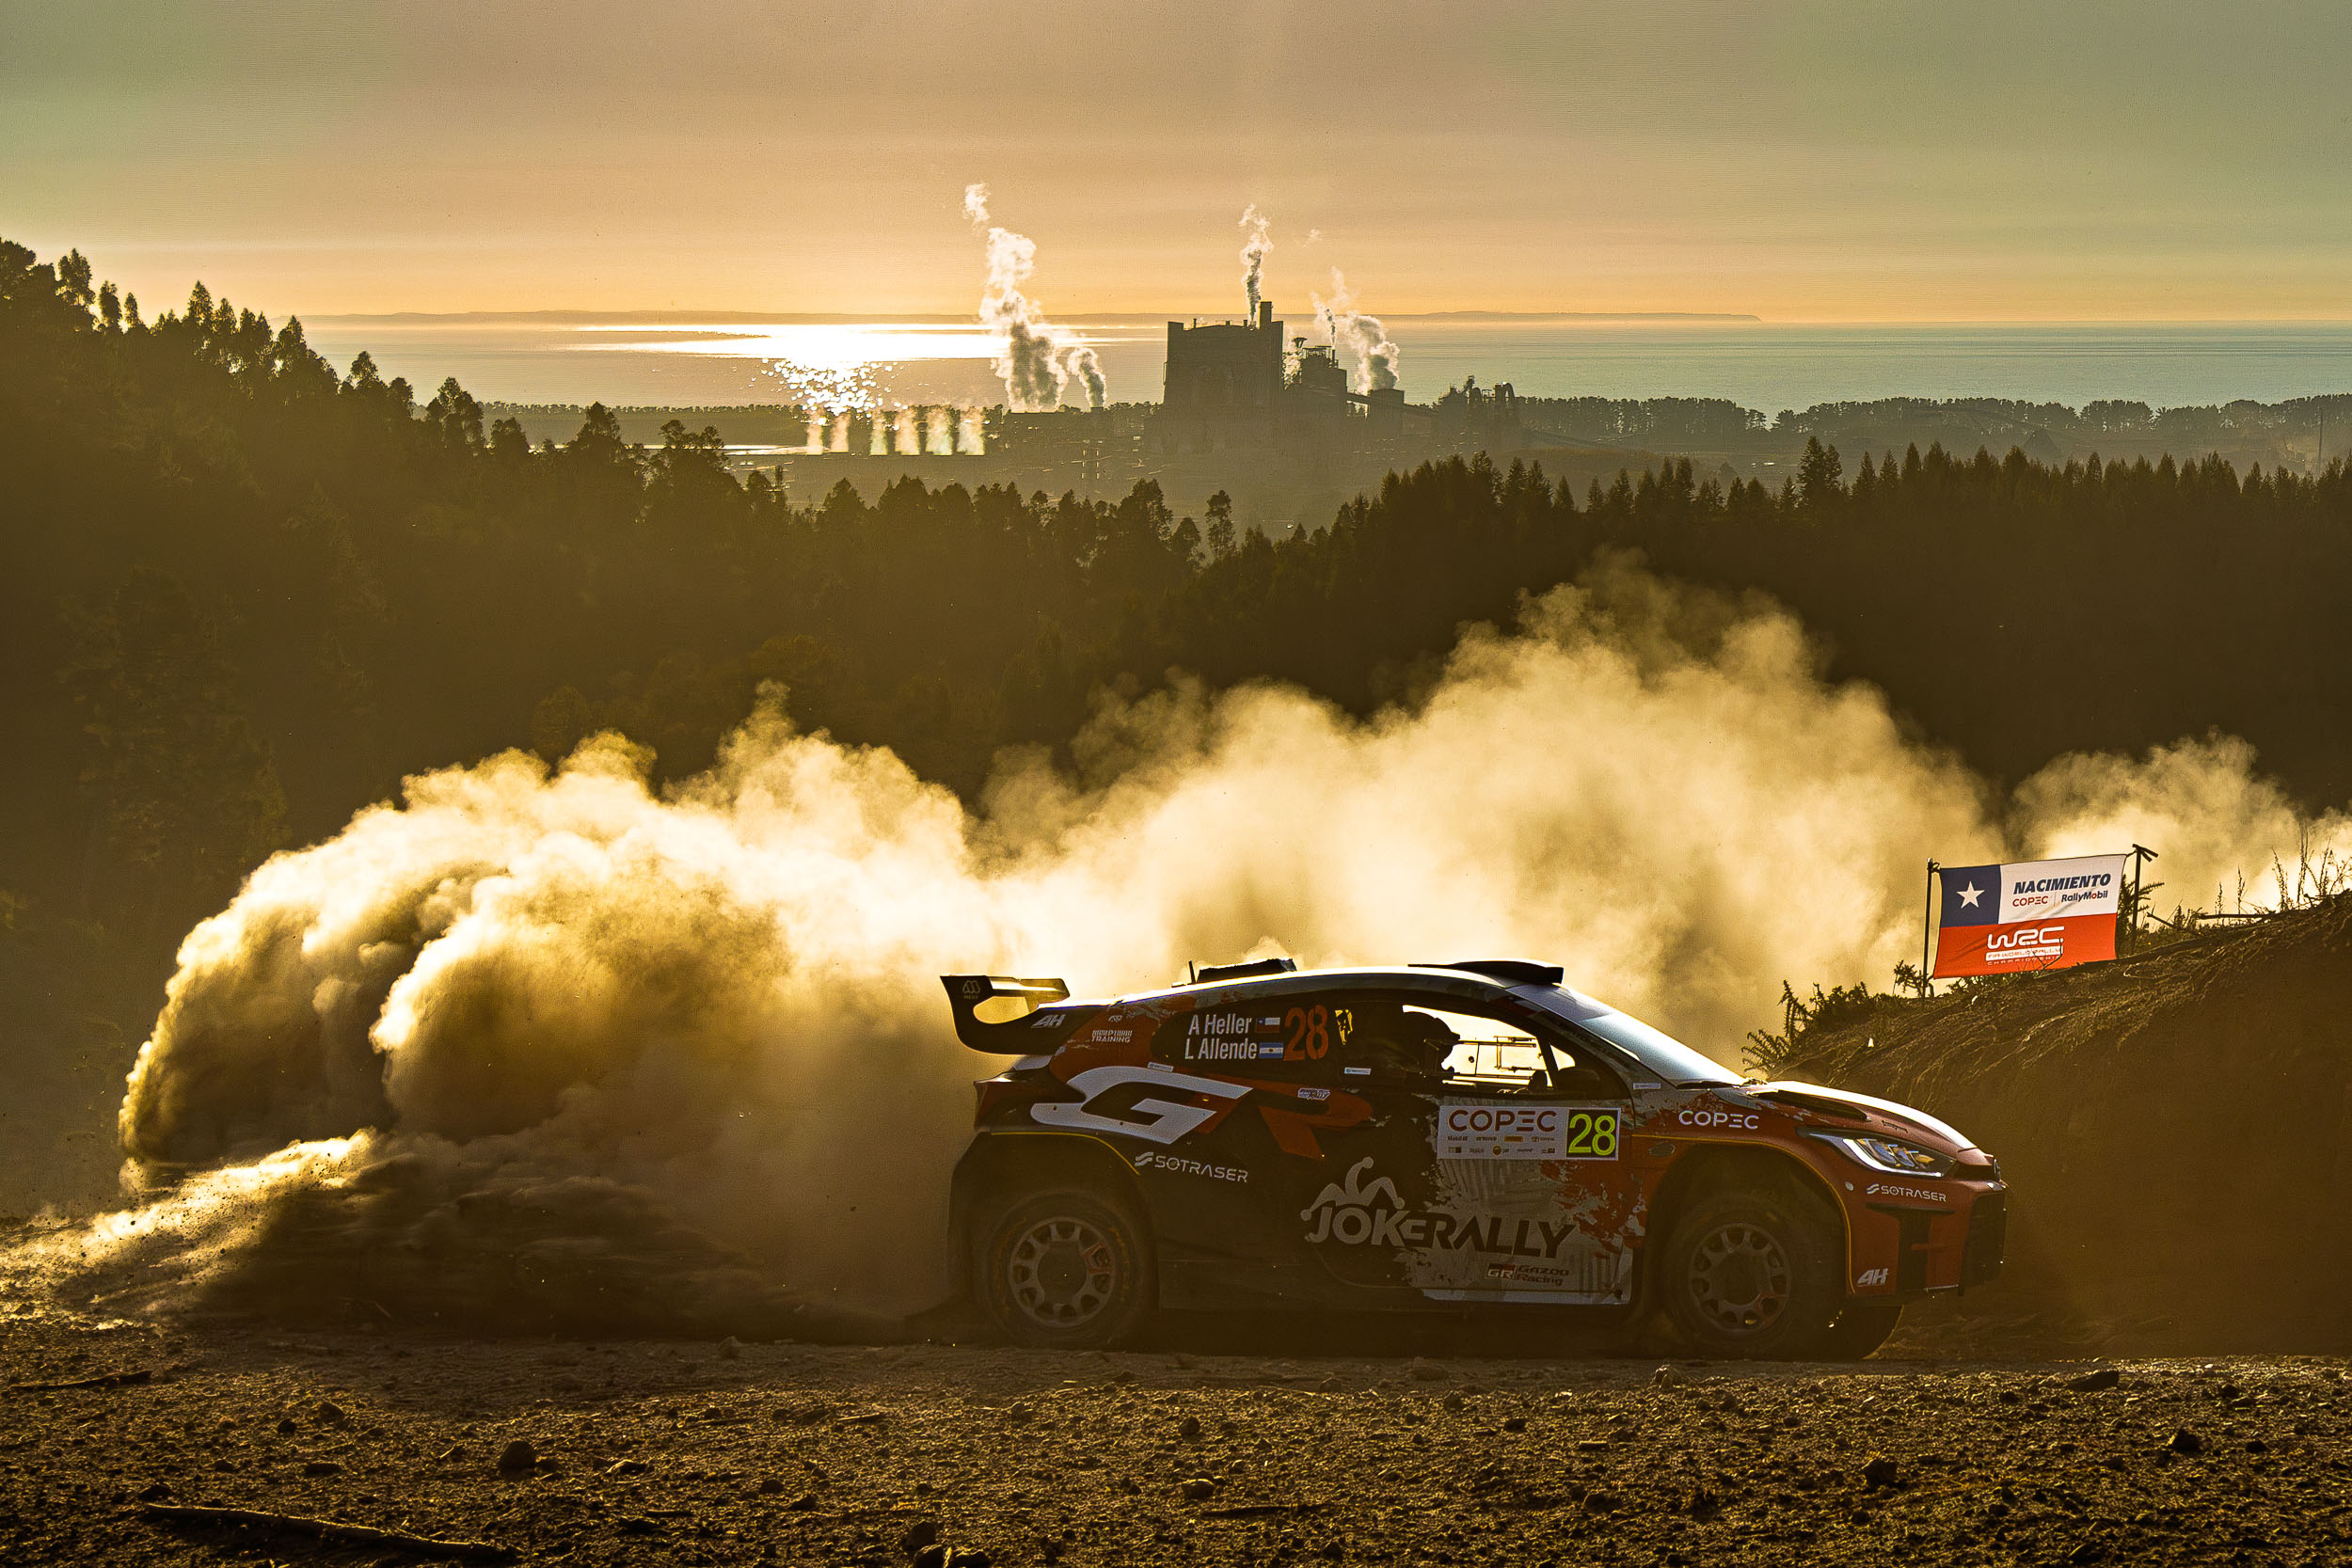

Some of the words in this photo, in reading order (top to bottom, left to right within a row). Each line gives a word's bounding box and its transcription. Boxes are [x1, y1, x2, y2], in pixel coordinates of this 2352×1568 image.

[2013, 873, 2111, 895] NACIMIENTO
[2012, 895, 2049, 907] COPEC
[2061, 890, 2108, 903] RallyMobil
[1987, 926, 2065, 950] WRC
[1188, 1015, 1200, 1036] A
[1204, 1013, 1252, 1035] Heller
[1283, 1005, 1329, 1062] 28
[1184, 1037, 1194, 1060] L
[1198, 1037, 1257, 1060] Allende
[1448, 1109, 1557, 1132] COPEC
[1678, 1110, 1759, 1130] COPEC
[1566, 1113, 1616, 1157] 28
[1154, 1154, 1248, 1183] SOTRASER
[1881, 1185, 1947, 1202] SOTRASER
[1305, 1206, 1578, 1259] JOKERALLY
[1486, 1269, 1514, 1279] GR
[1517, 1274, 1563, 1286] Racing
